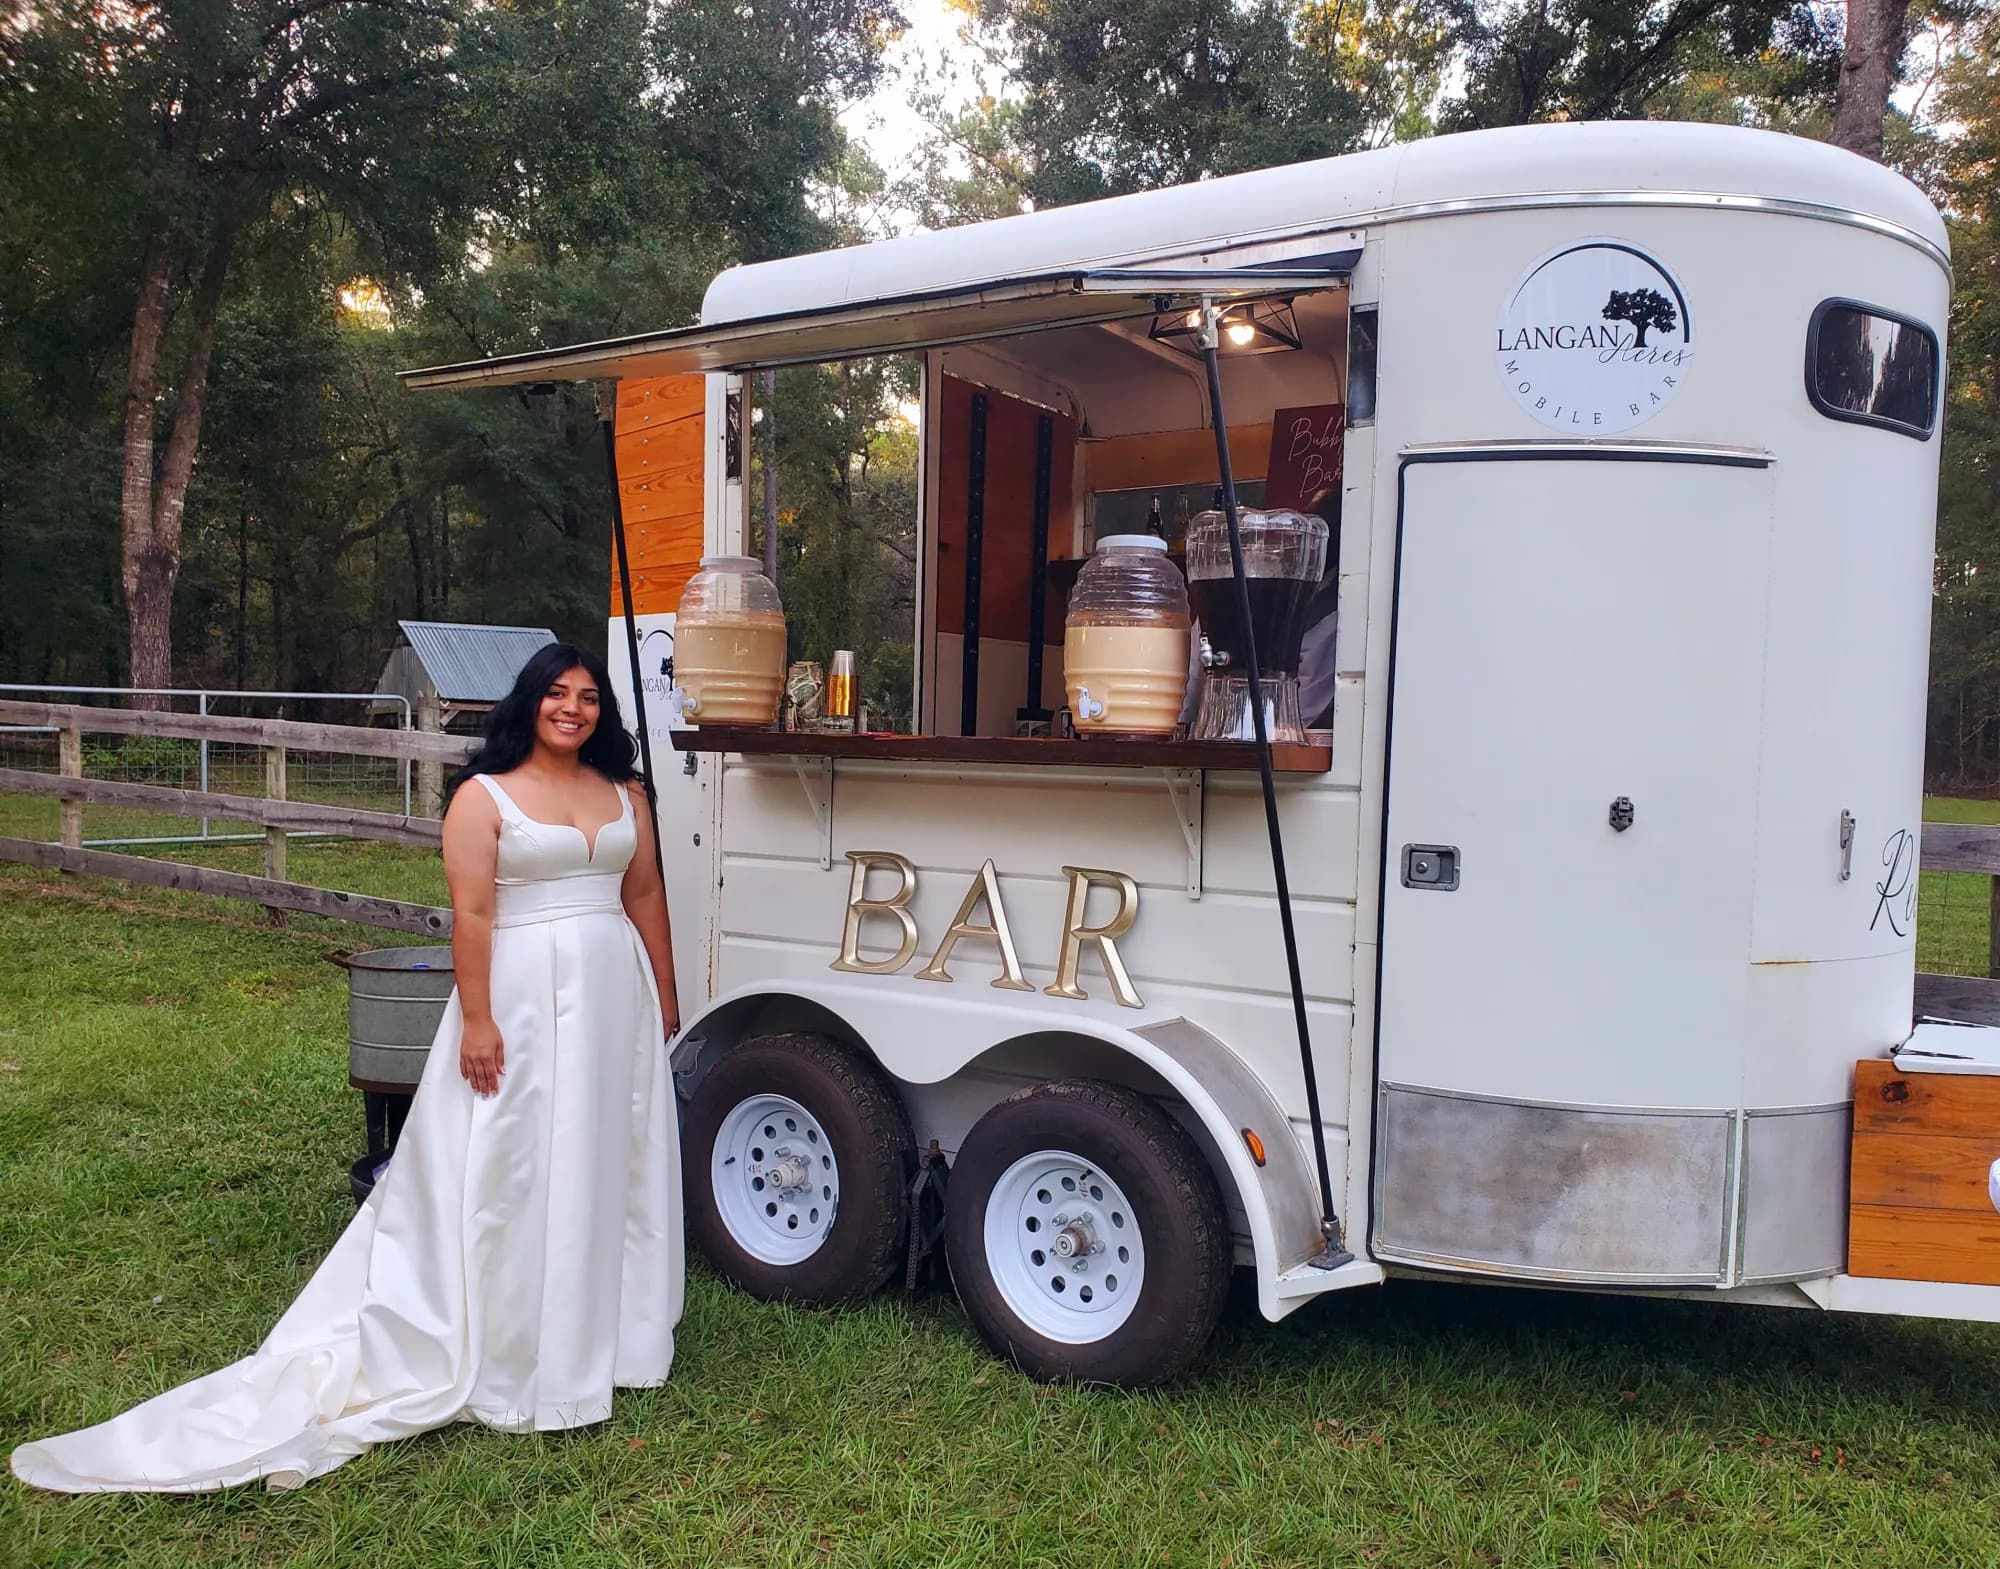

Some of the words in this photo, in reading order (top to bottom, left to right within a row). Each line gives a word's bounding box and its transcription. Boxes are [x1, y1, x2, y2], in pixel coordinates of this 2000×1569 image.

[1496, 325, 1620, 352] LANGAN
[1598, 332, 1694, 367] Acres
[1504, 359, 1602, 425] MOBILE
[1629, 375, 1677, 417] BAR
[829, 850, 1145, 1010] BAR
